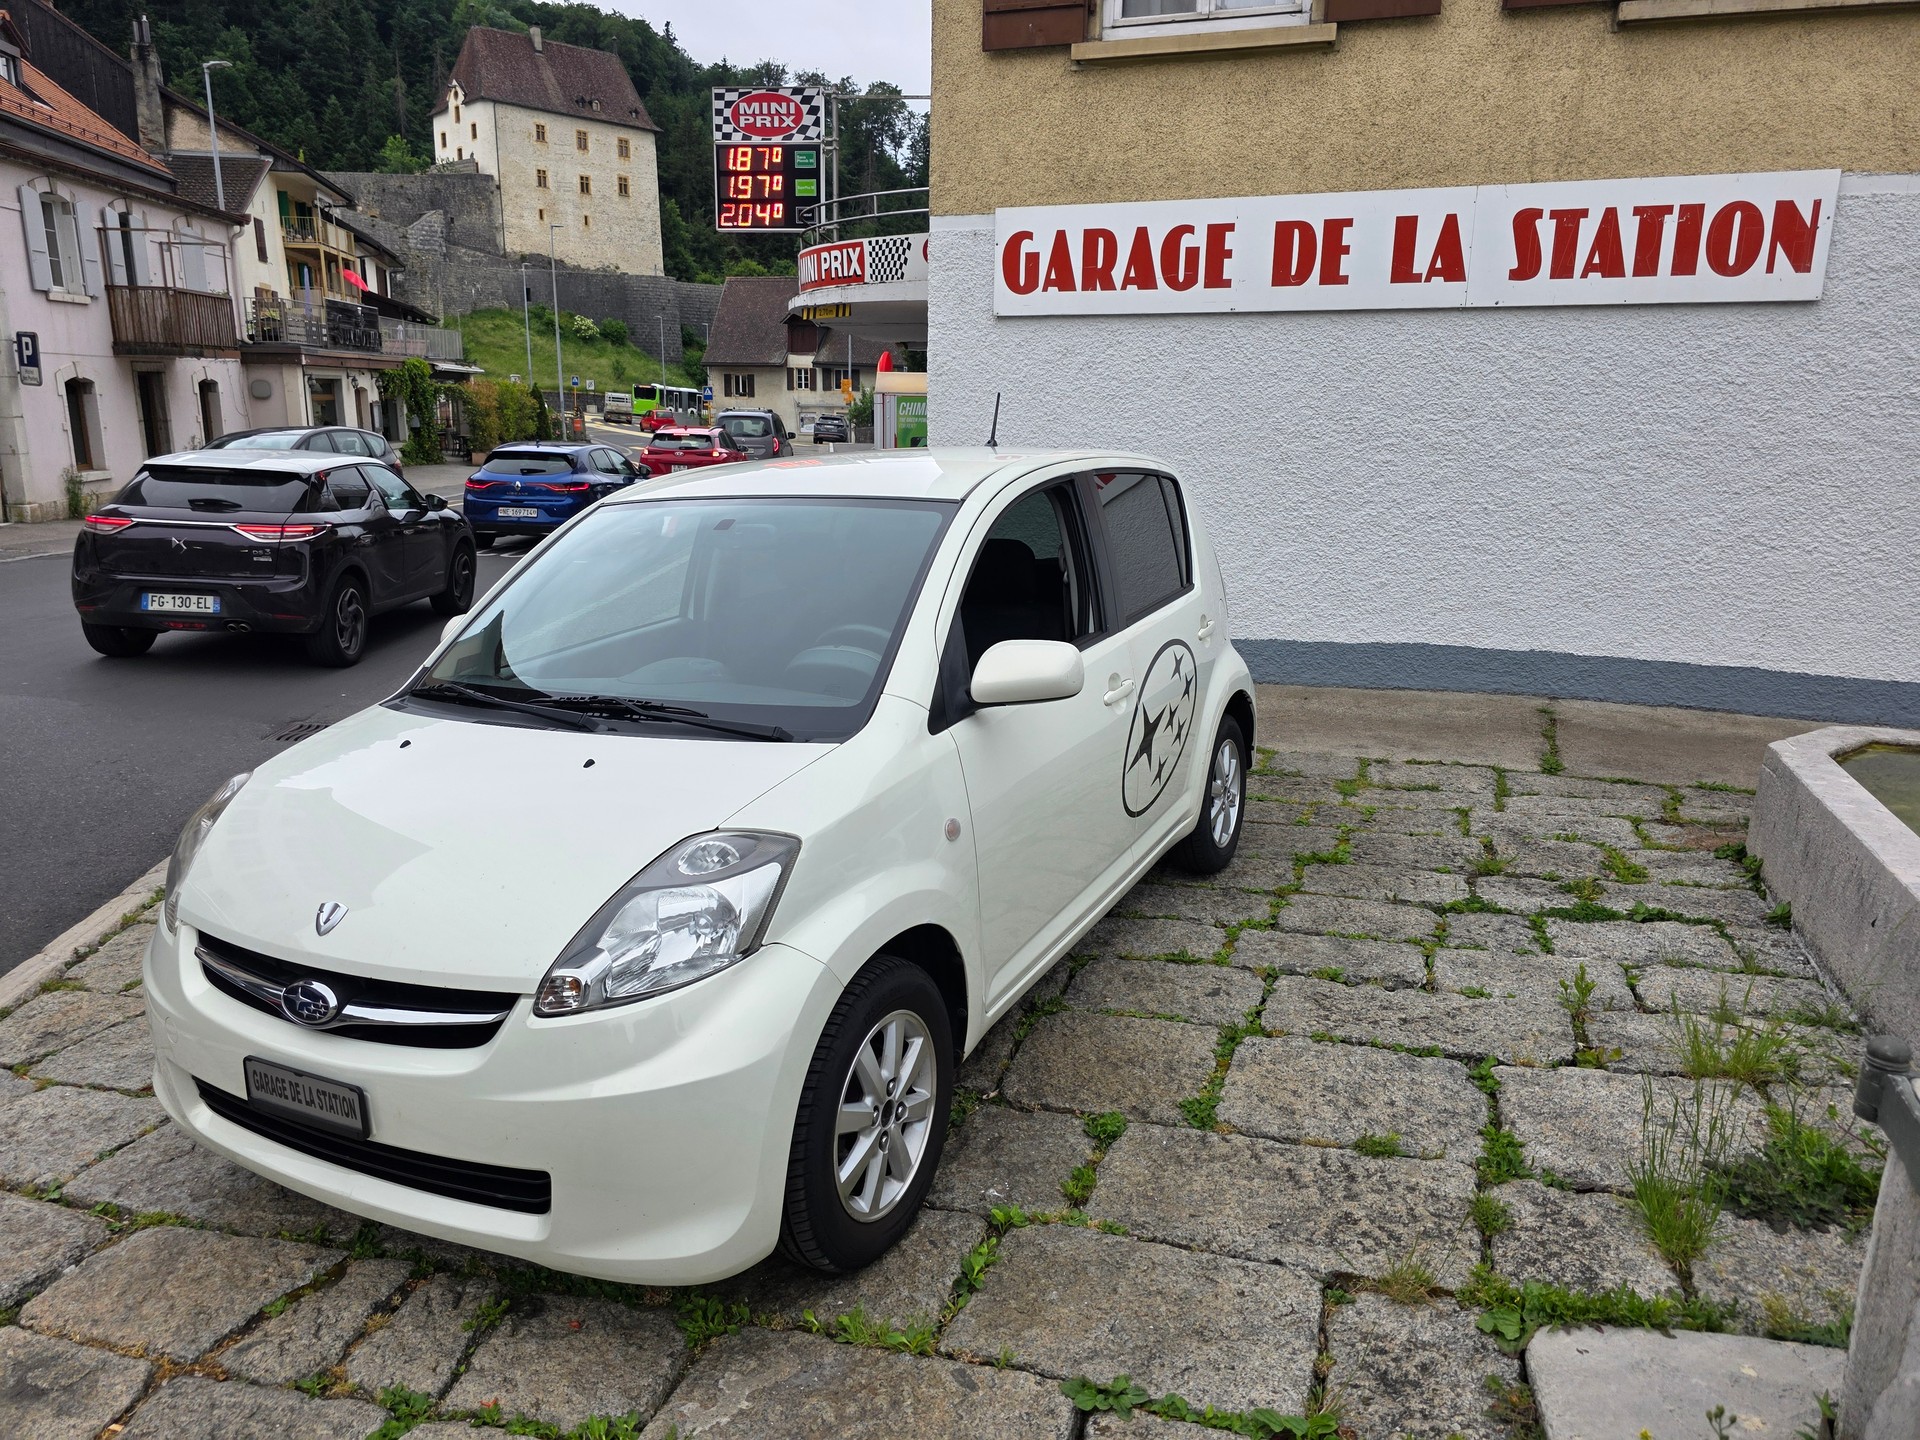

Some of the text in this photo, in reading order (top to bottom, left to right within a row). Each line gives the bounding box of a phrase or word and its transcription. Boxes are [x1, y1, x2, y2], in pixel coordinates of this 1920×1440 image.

[738, 102, 796, 114] MINI
[739, 116, 797, 128] PRIX
[1002, 198, 1822, 295] GARAGE DE LA STATION
[820, 247, 862, 280] PRIX
[22, 336, 33, 364] P
[899, 402, 928, 415] CHIM
[150, 595, 211, 609] FG-130-EL
[252, 1069, 358, 1120] GARAGE DE LA STATION
